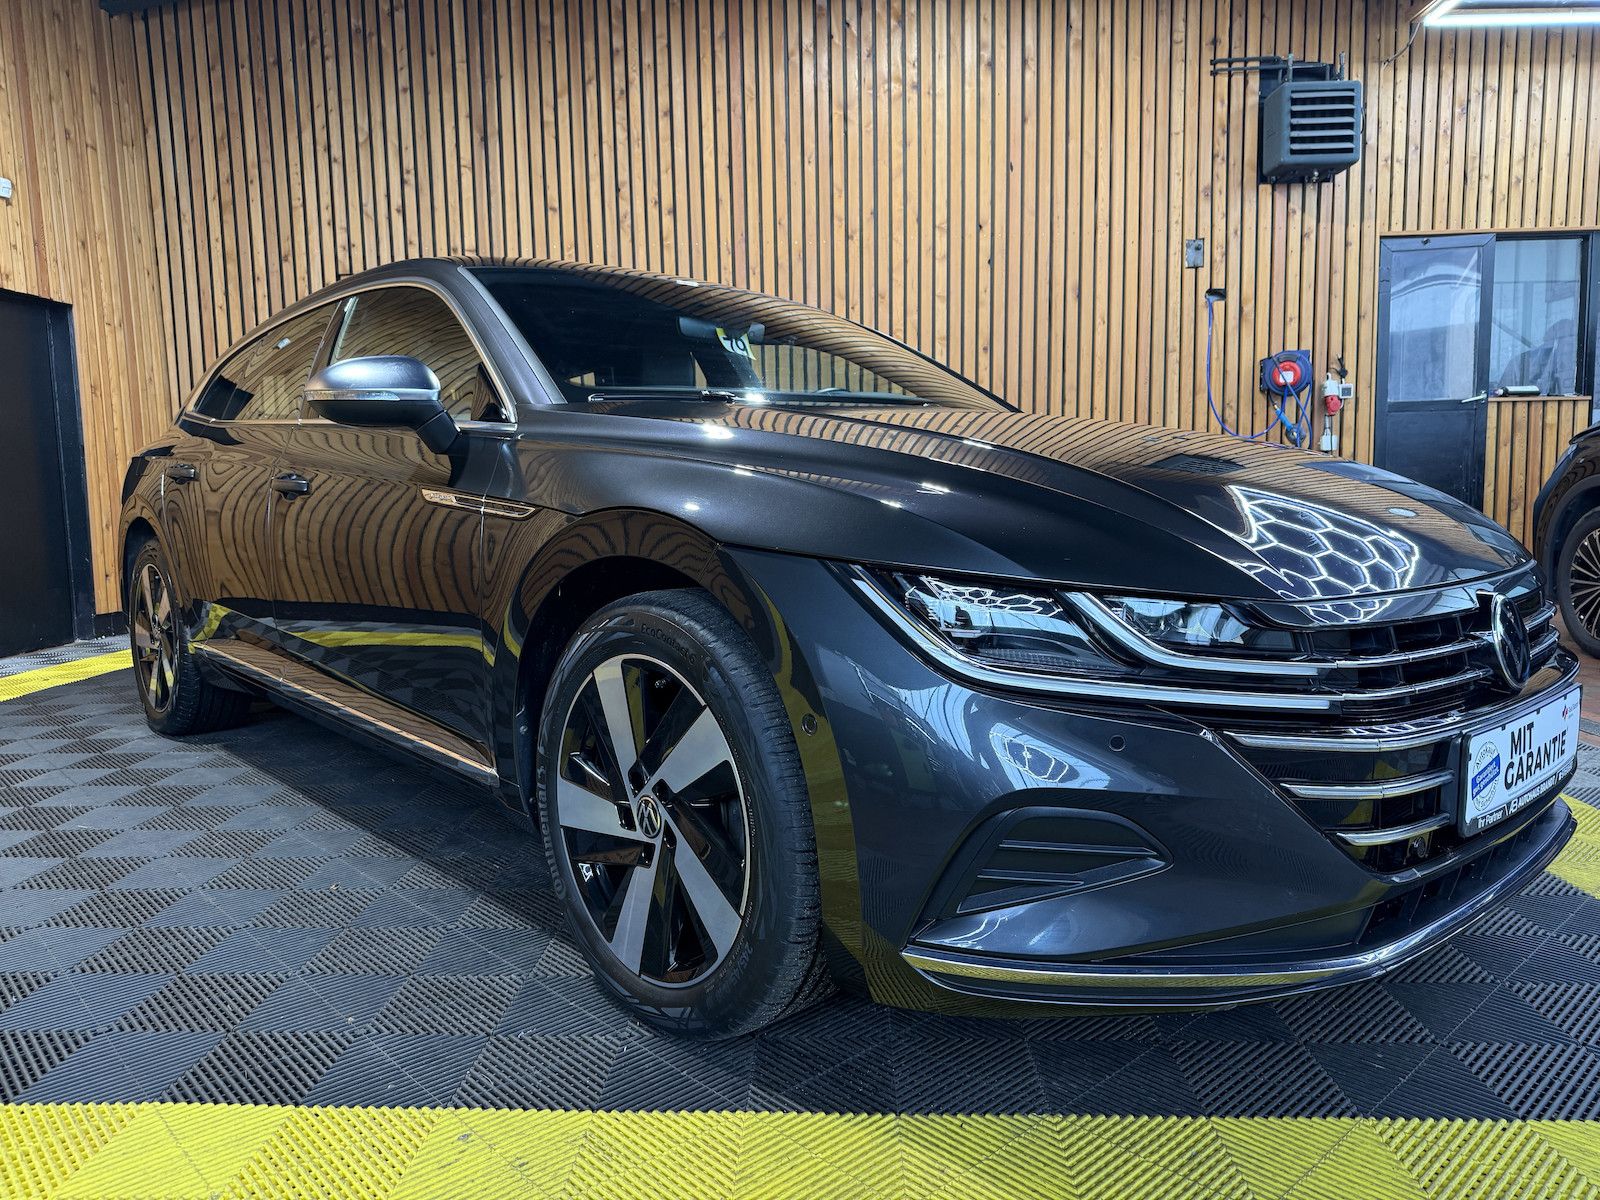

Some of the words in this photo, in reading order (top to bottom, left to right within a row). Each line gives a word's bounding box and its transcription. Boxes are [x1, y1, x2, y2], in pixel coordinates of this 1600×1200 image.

[1504, 729, 1567, 790] GARANTIE
[1510, 722, 1534, 759] MIT
[538, 783, 566, 899] Continental
